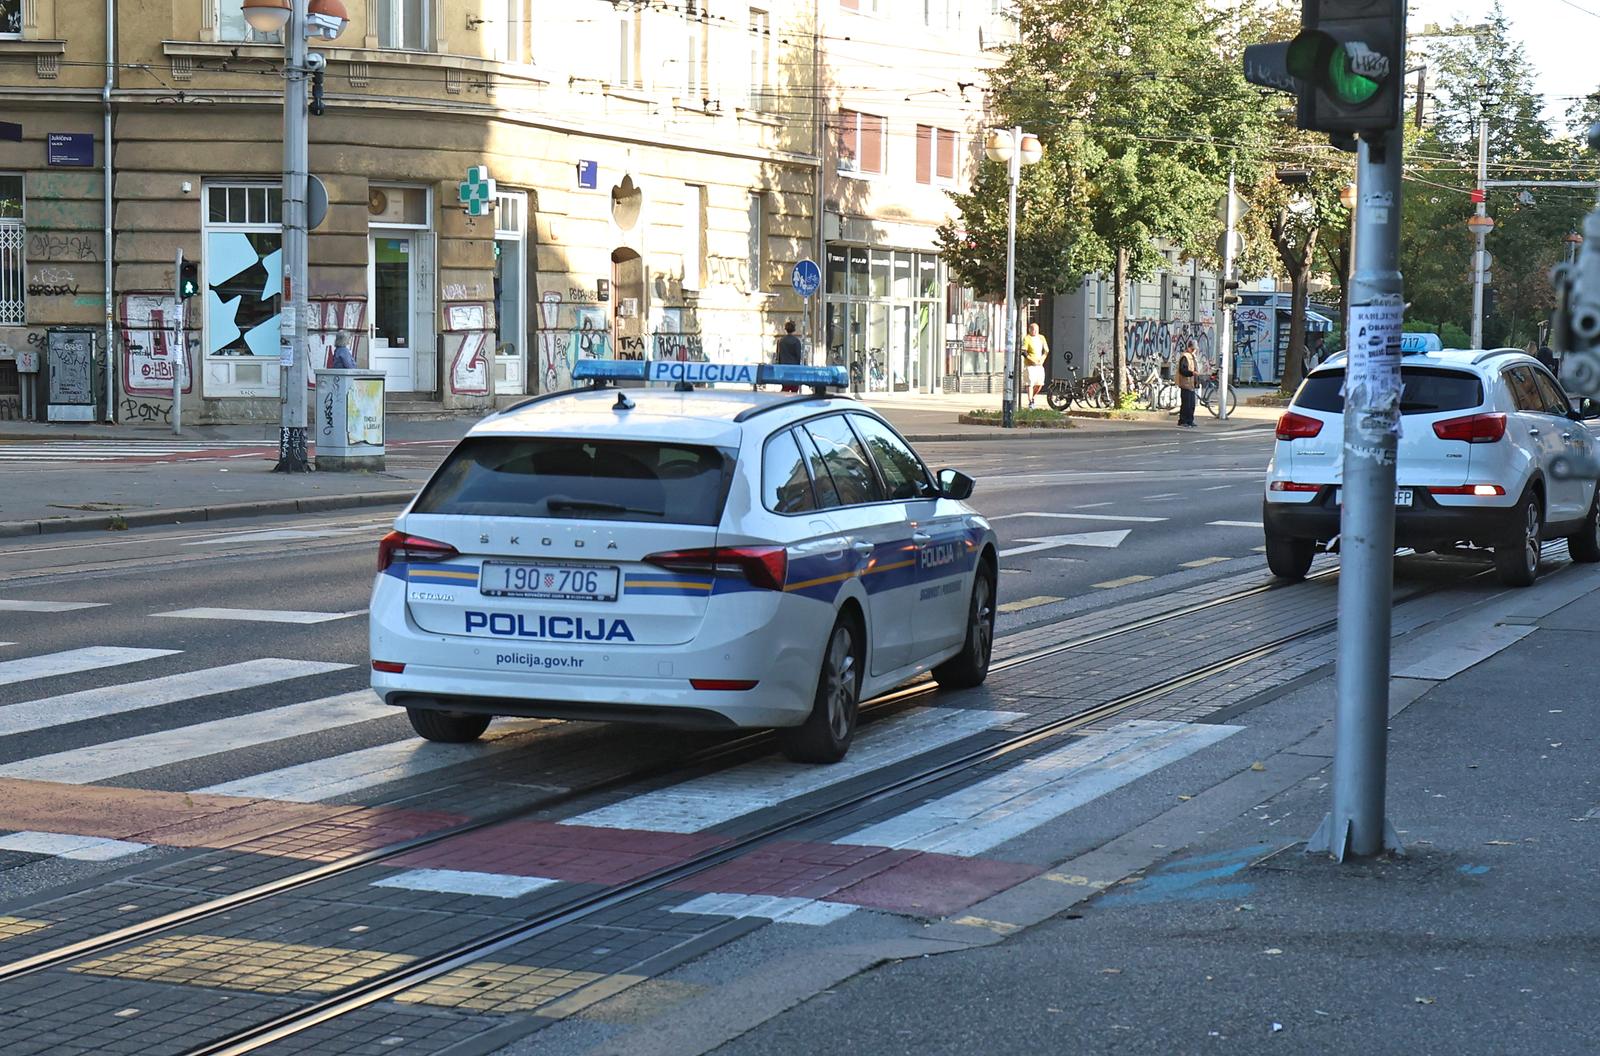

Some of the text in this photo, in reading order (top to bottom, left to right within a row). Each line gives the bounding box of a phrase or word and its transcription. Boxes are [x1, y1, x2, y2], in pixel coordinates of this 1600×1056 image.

[656, 363, 751, 382] POLICIJA
[480, 533, 618, 550] ŠKODA
[921, 543, 954, 569] POLICIJA
[504, 567, 599, 593] 190 706
[464, 610, 636, 642] POLICIJA
[495, 652, 585, 669] policija.gov.hr
